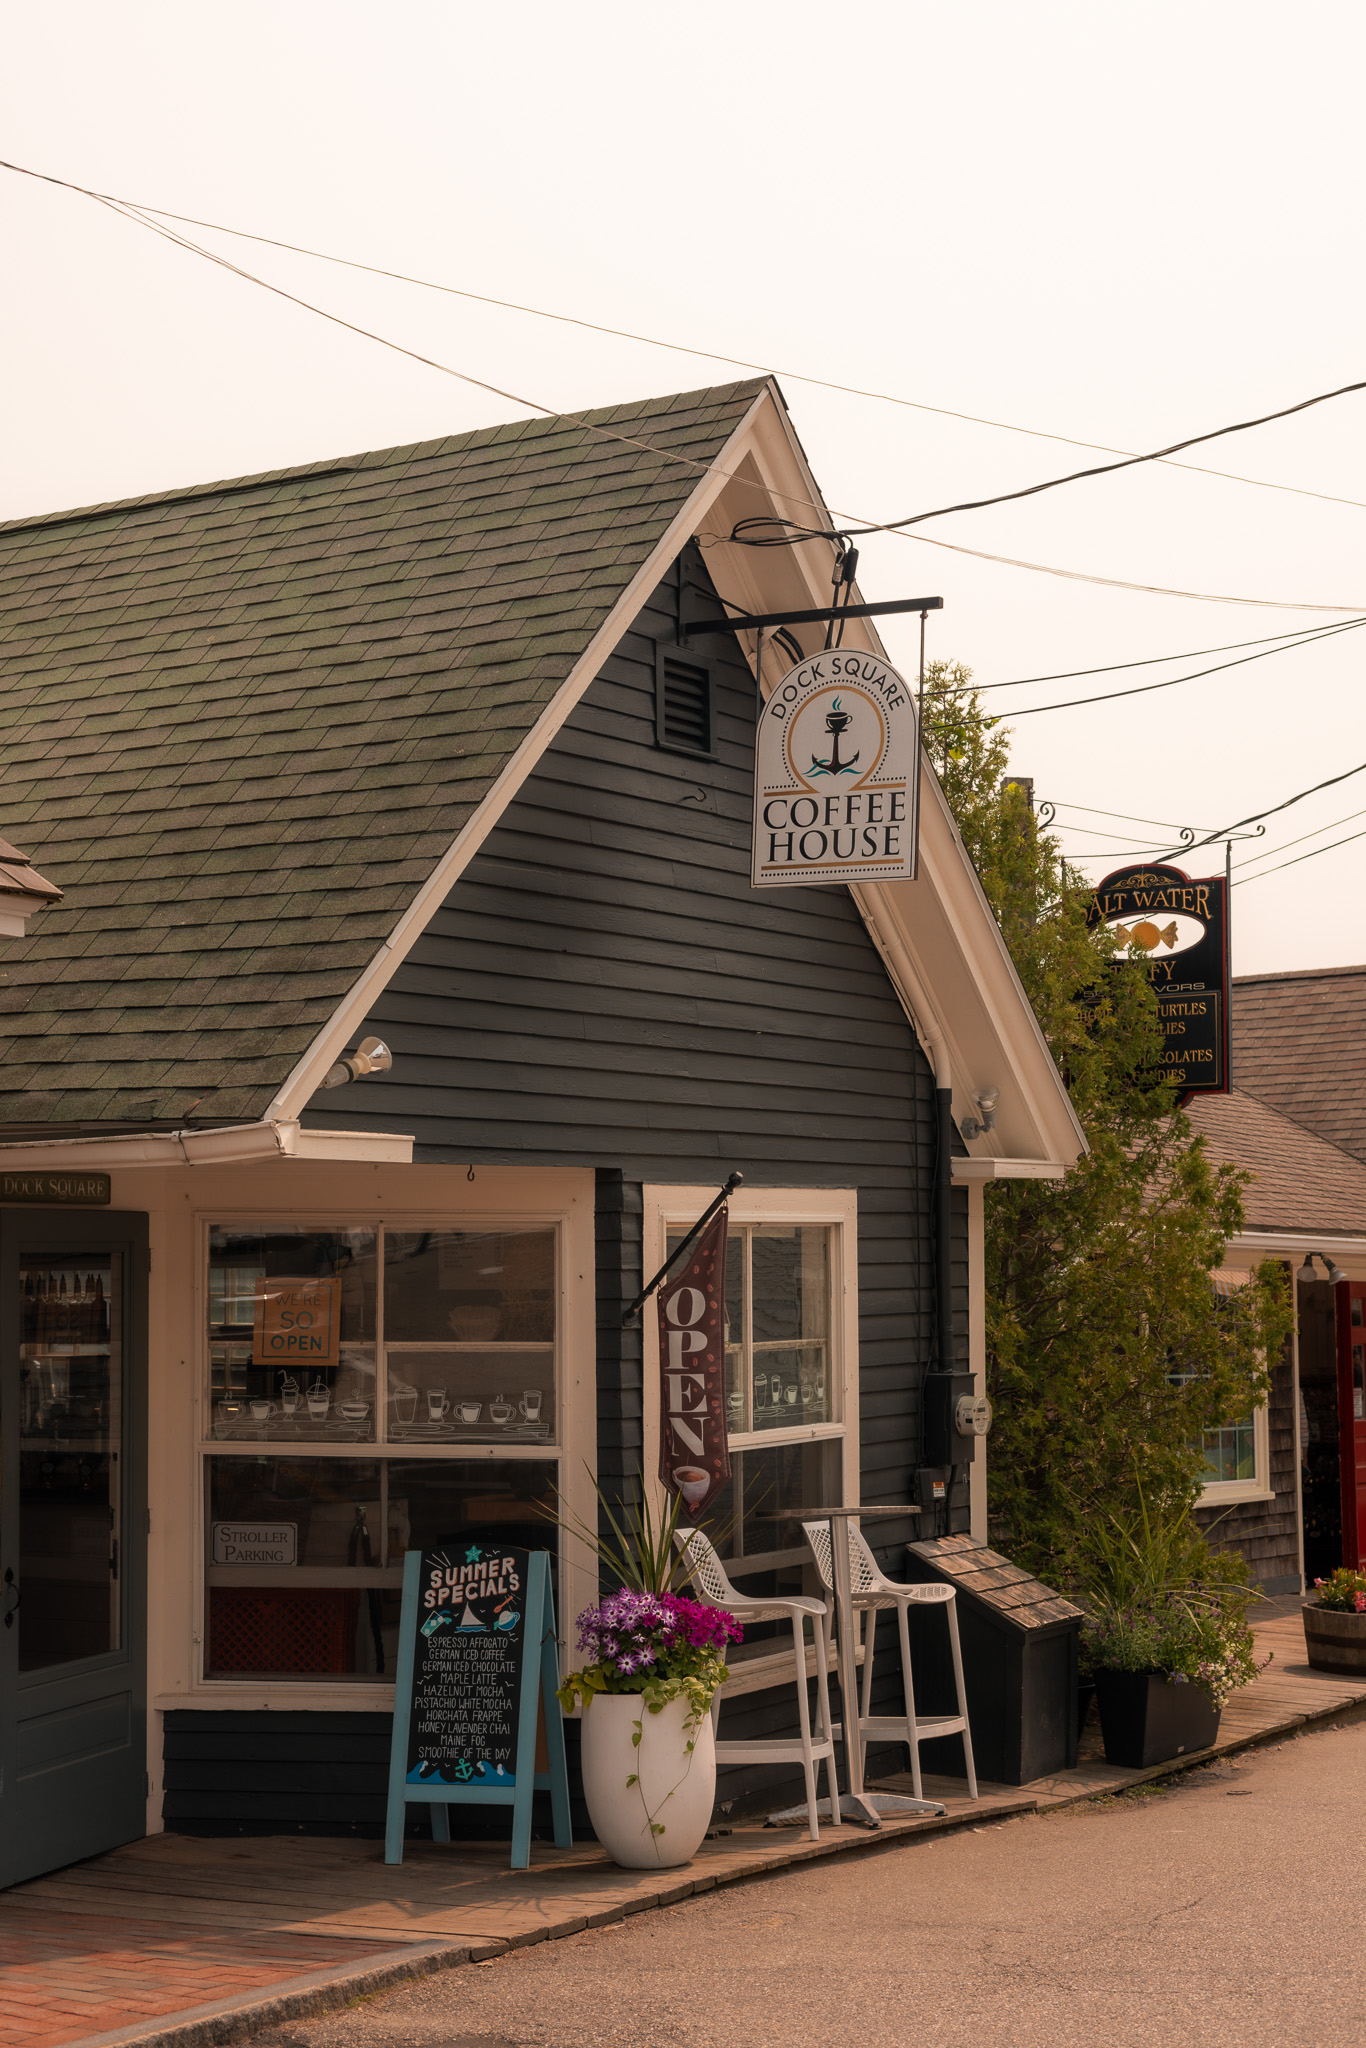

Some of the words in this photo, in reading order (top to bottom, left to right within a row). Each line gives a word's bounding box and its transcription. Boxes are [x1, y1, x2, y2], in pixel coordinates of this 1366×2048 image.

[771, 661, 825, 720] DOCK
[831, 657, 905, 711] SQUARE
[763, 791, 906, 829] COFFEE
[767, 825, 901, 862] HOUSE
[1085, 894, 1127, 922] ALT
[1133, 887, 1212, 920] WATER
[1155, 1002, 1207, 1017] TURTLES
[4, 1177, 45, 1195] DOCK
[49, 1179, 105, 1200] SQUARE
[275, 1293, 321, 1306] WE'RE
[280, 1311, 314, 1330] SO
[270, 1335, 322, 1350] OPEN
[664, 1286, 711, 1457] OPEN
[220, 1527, 288, 1543] STROLLER
[225, 1545, 284, 1561] PARKING
[430, 1557, 515, 1589] SUMMER
[424, 1573, 520, 1608] SPECIALS
[428, 1637, 467, 1648] ESPRESSO
[469, 1637, 508, 1649] AFFOGATO
[429, 1649, 460, 1660] GERMAN
[480, 1649, 506, 1660] COFFEE
[422, 1661, 452, 1672] GERMAN
[471, 1661, 516, 1672] CHOCOLATE
[440, 1673, 470, 1685] MAPLE
[471, 1673, 498, 1685] LATTE
[423, 1685, 473, 1697] HAZELNUT
[475, 1686, 504, 1697] MOCHA
[483, 1698, 513, 1710] MOCHA
[426, 1710, 468, 1721] HORCHATA
[472, 1710, 503, 1722] FRAPPE
[418, 1721, 447, 1733] HONEY
[447, 1722, 488, 1734] LAVENDER
[471, 1735, 486, 1747] FOG
[463, 1747, 474, 1759] OF
[475, 1748, 492, 1759] THE
[495, 1748, 512, 1760] DAY
